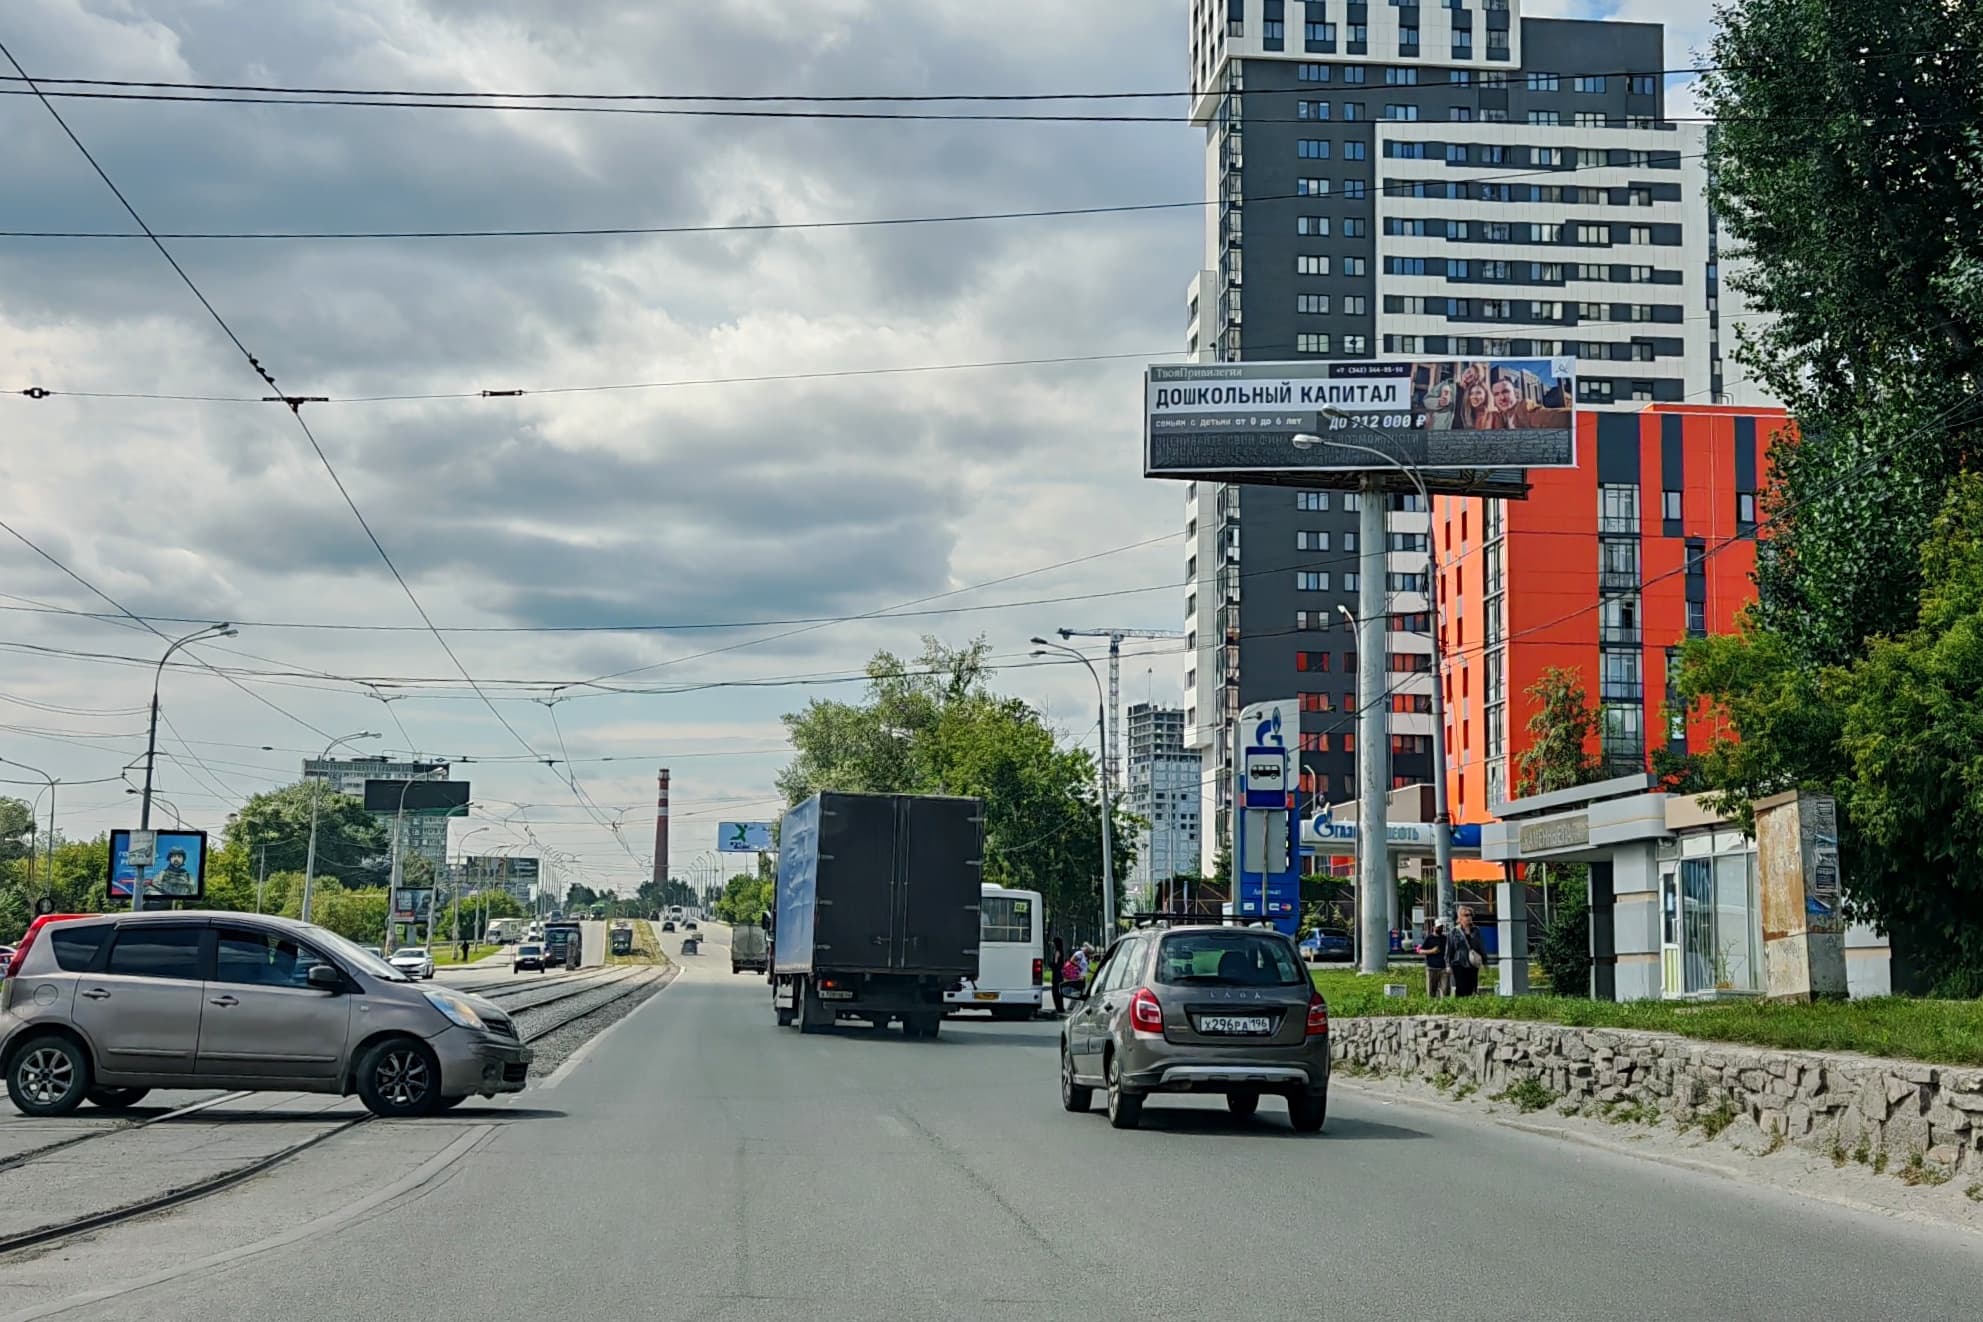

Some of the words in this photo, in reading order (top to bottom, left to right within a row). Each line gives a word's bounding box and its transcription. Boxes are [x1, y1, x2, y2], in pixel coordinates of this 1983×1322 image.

[1156, 382, 1292, 409] ДОШКОЛЬНЫЙ
[1300, 385, 1396, 403] КАПИТАЛ
[1250, 416, 1257, 425] 0
[1260, 418, 1272, 426] до
[1276, 416, 1282, 425] 6
[1286, 417, 1302, 425] лет
[1383, 414, 1411, 428] 000
[1250, 1018, 1267, 1028] 196
